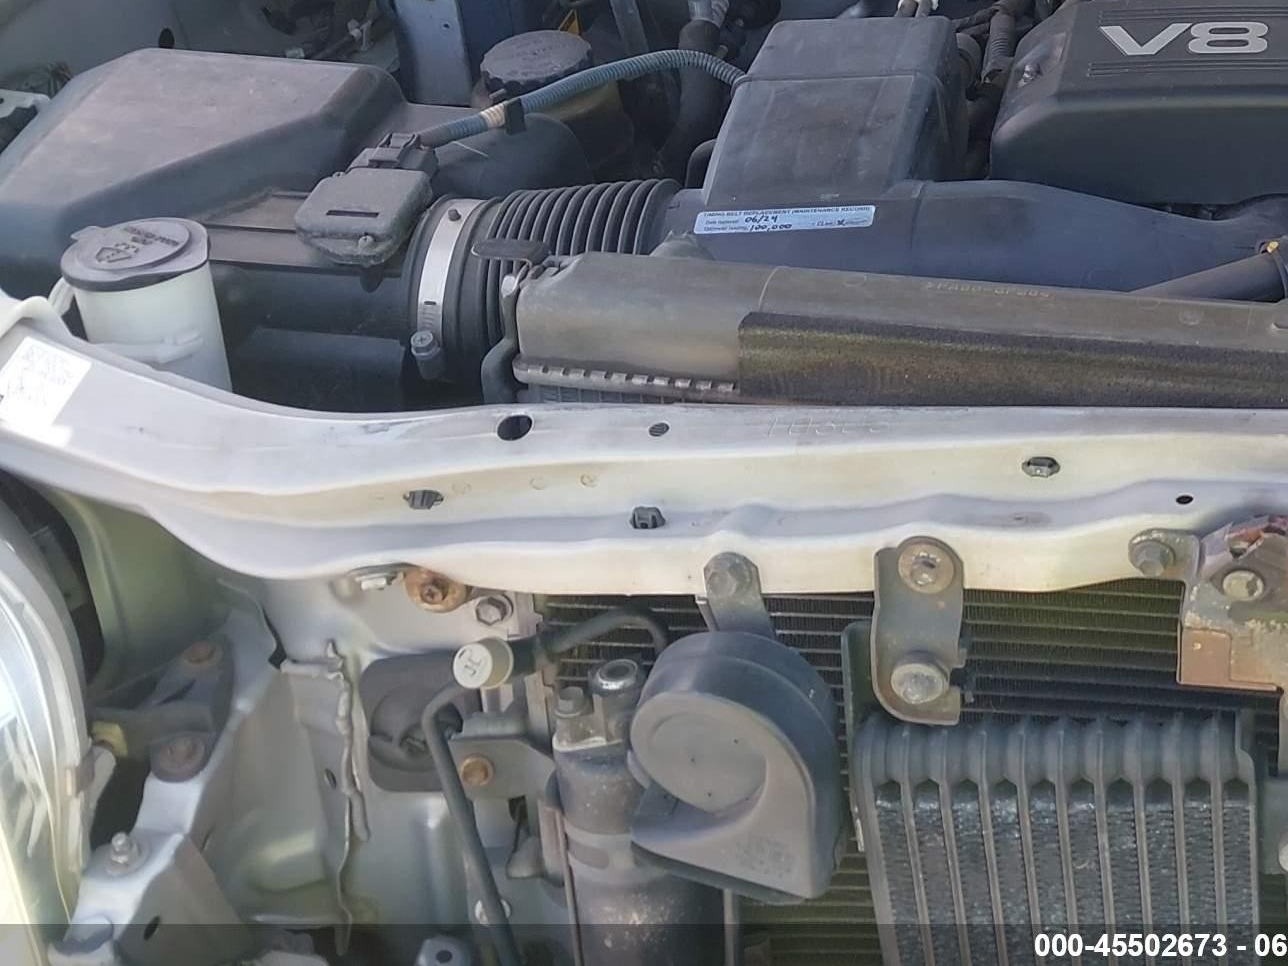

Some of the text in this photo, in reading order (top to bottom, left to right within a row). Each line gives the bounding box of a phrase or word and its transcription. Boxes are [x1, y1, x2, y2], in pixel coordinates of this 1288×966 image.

[1099, 21, 1270, 57] V8
[744, 214, 778, 224] 06/24
[750, 223, 793, 233] 100,000
